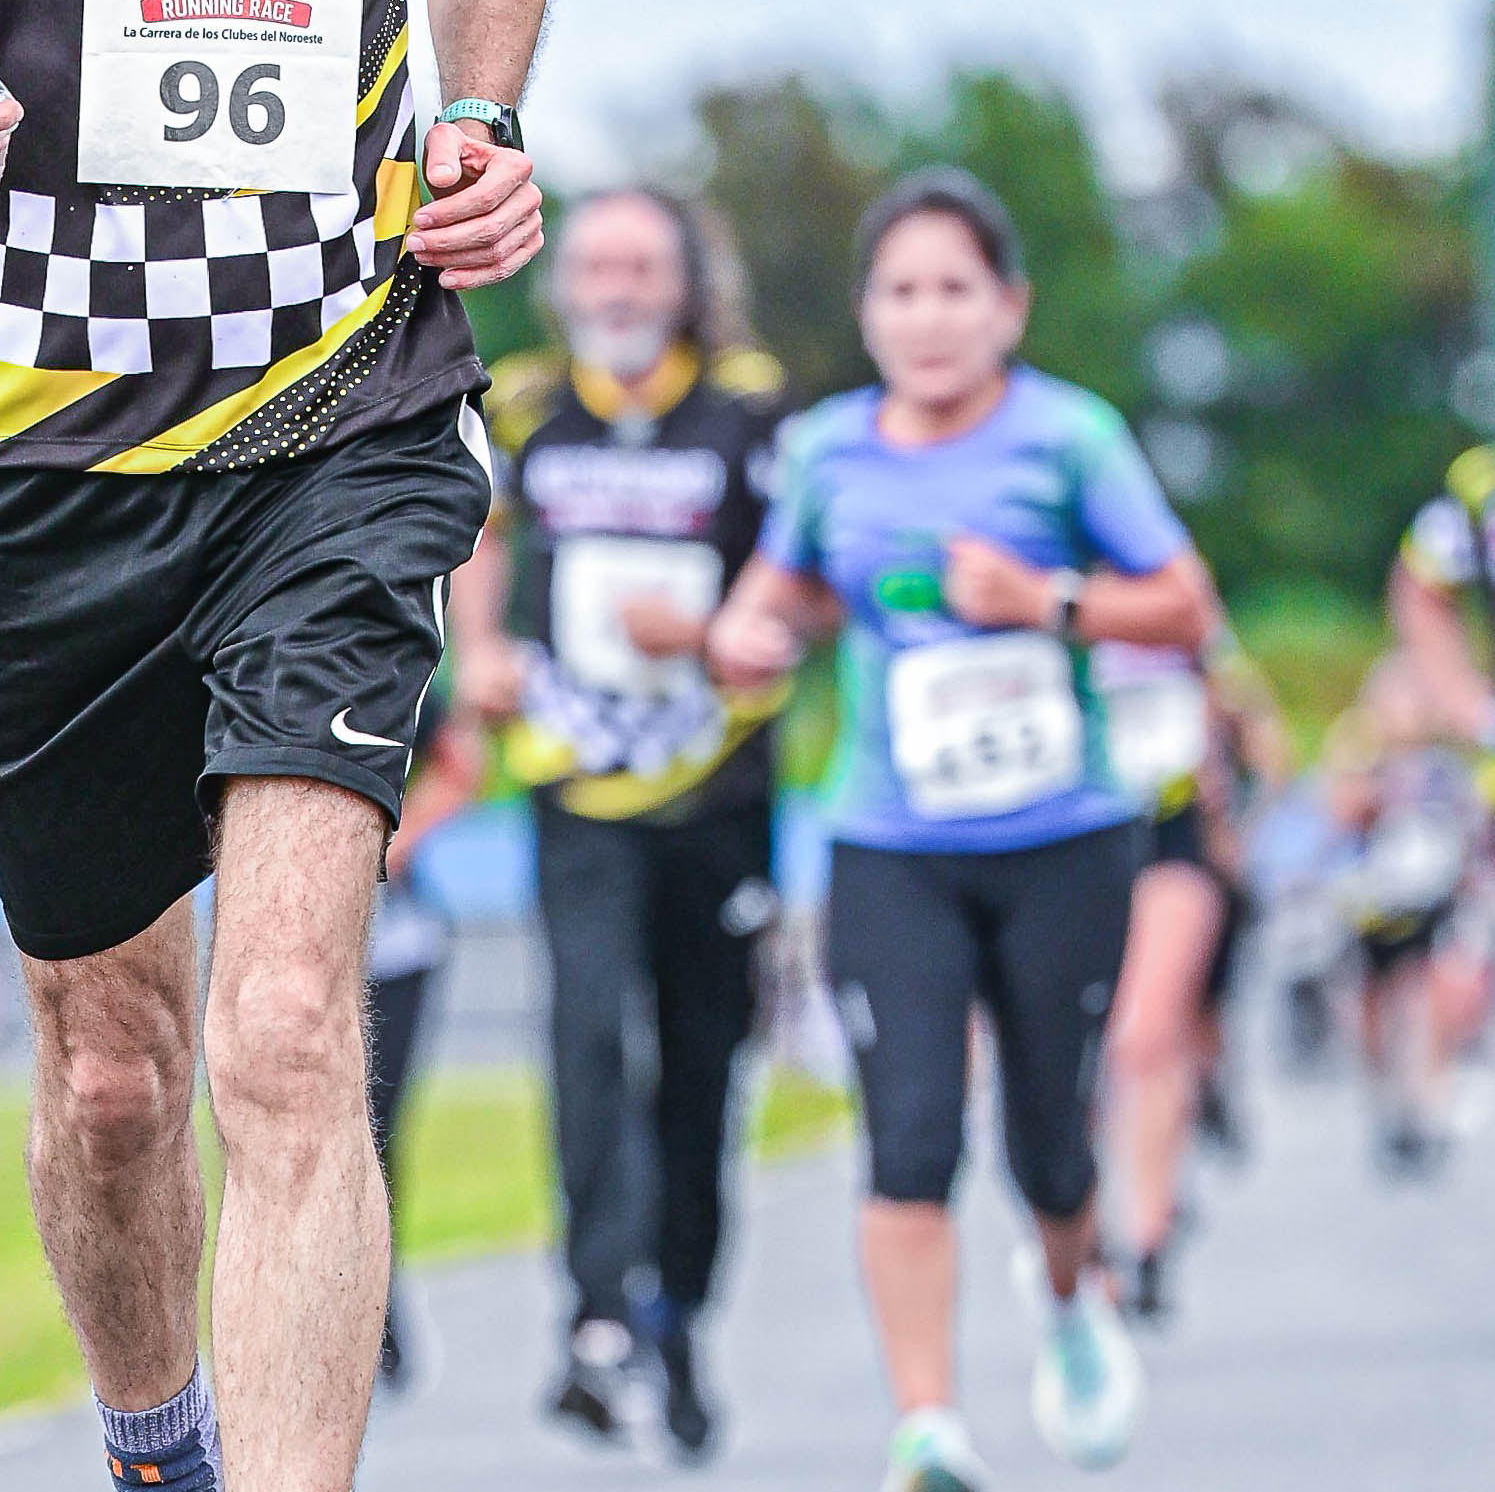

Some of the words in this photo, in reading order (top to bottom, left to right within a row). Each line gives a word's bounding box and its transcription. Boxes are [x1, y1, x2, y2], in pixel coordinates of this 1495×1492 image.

[249, 0, 295, 23] RACE
[123, 26, 137, 38] La
[139, 27, 182, 39] Carrera
[185, 27, 200, 39] de
[202, 28, 219, 40] los
[221, 28, 258, 41] Clubes
[260, 30, 277, 42] del
[279, 31, 323, 45] Noroeste
[159, 59, 287, 145] 96
